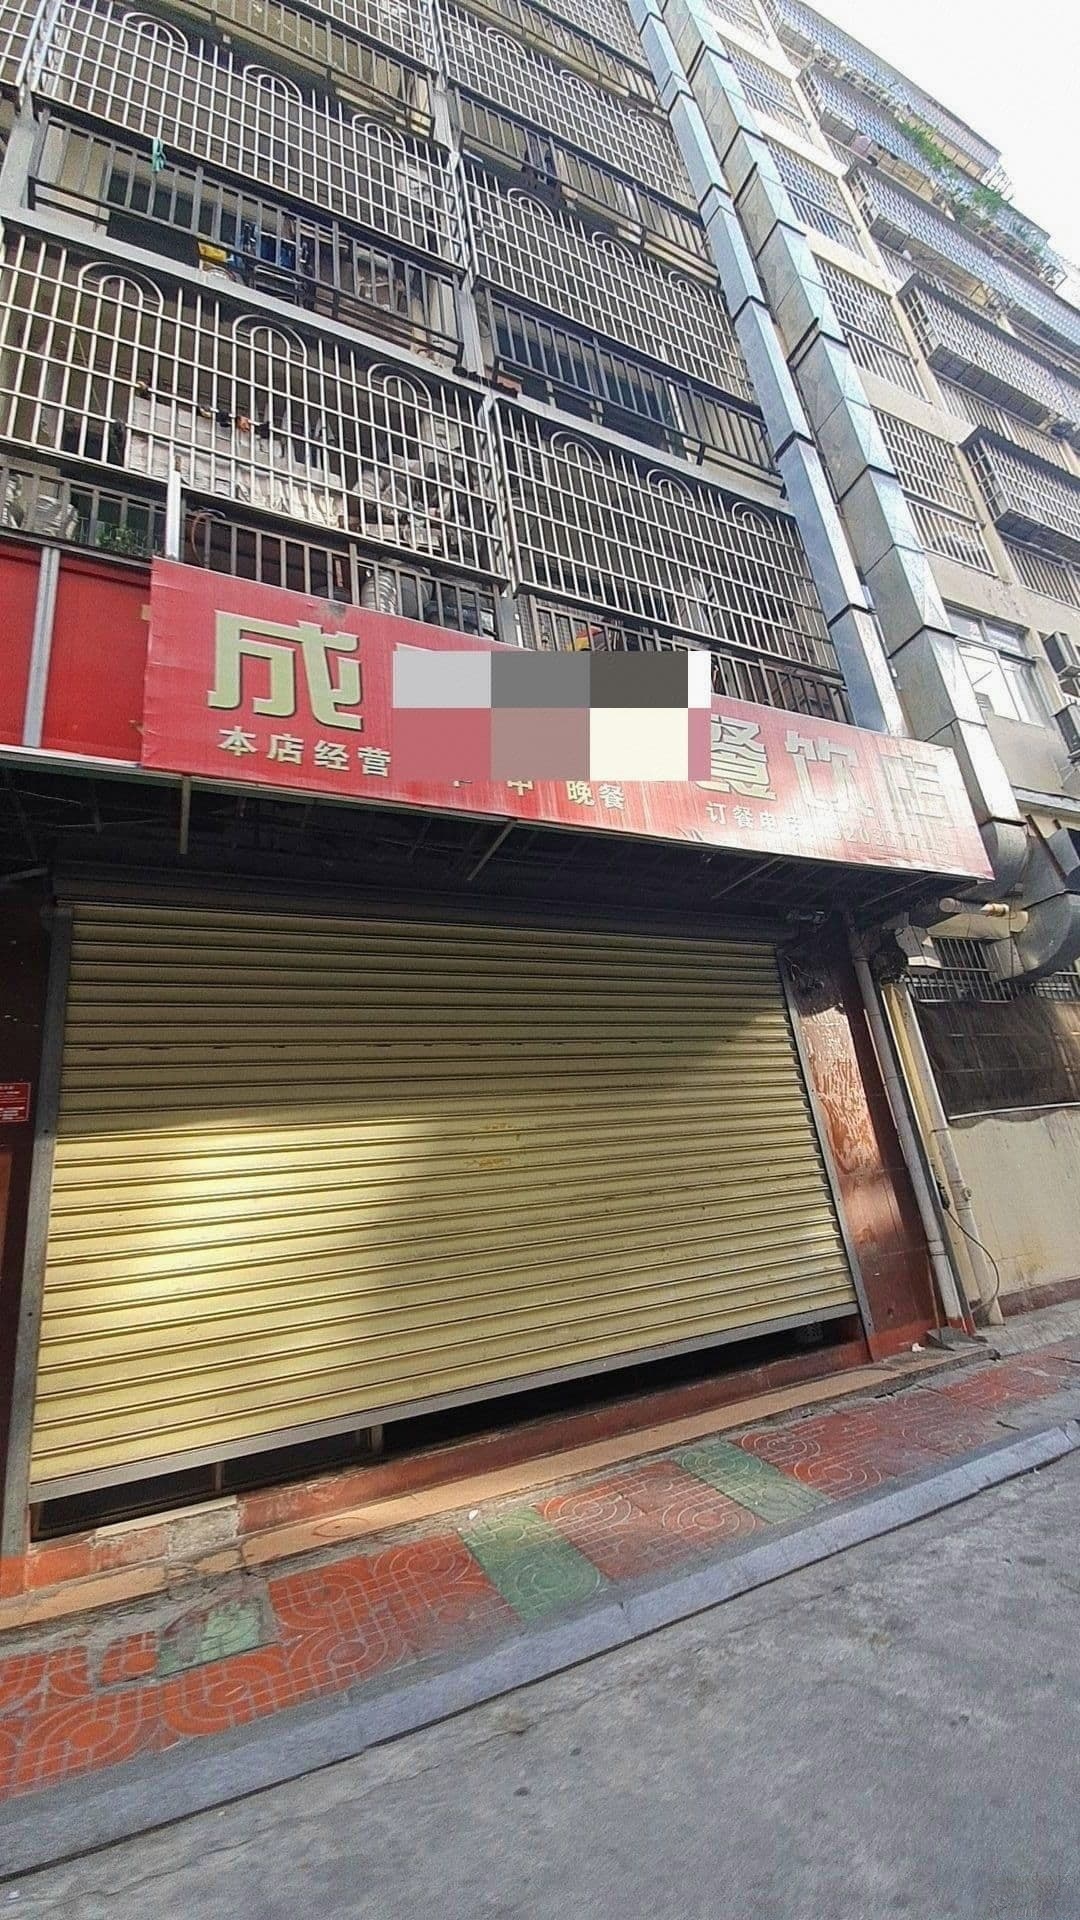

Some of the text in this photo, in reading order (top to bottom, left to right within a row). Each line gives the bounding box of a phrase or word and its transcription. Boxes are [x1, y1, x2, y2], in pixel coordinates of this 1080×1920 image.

[207, 610, 363, 731] 成
[217, 725, 392, 778] 本店经营
